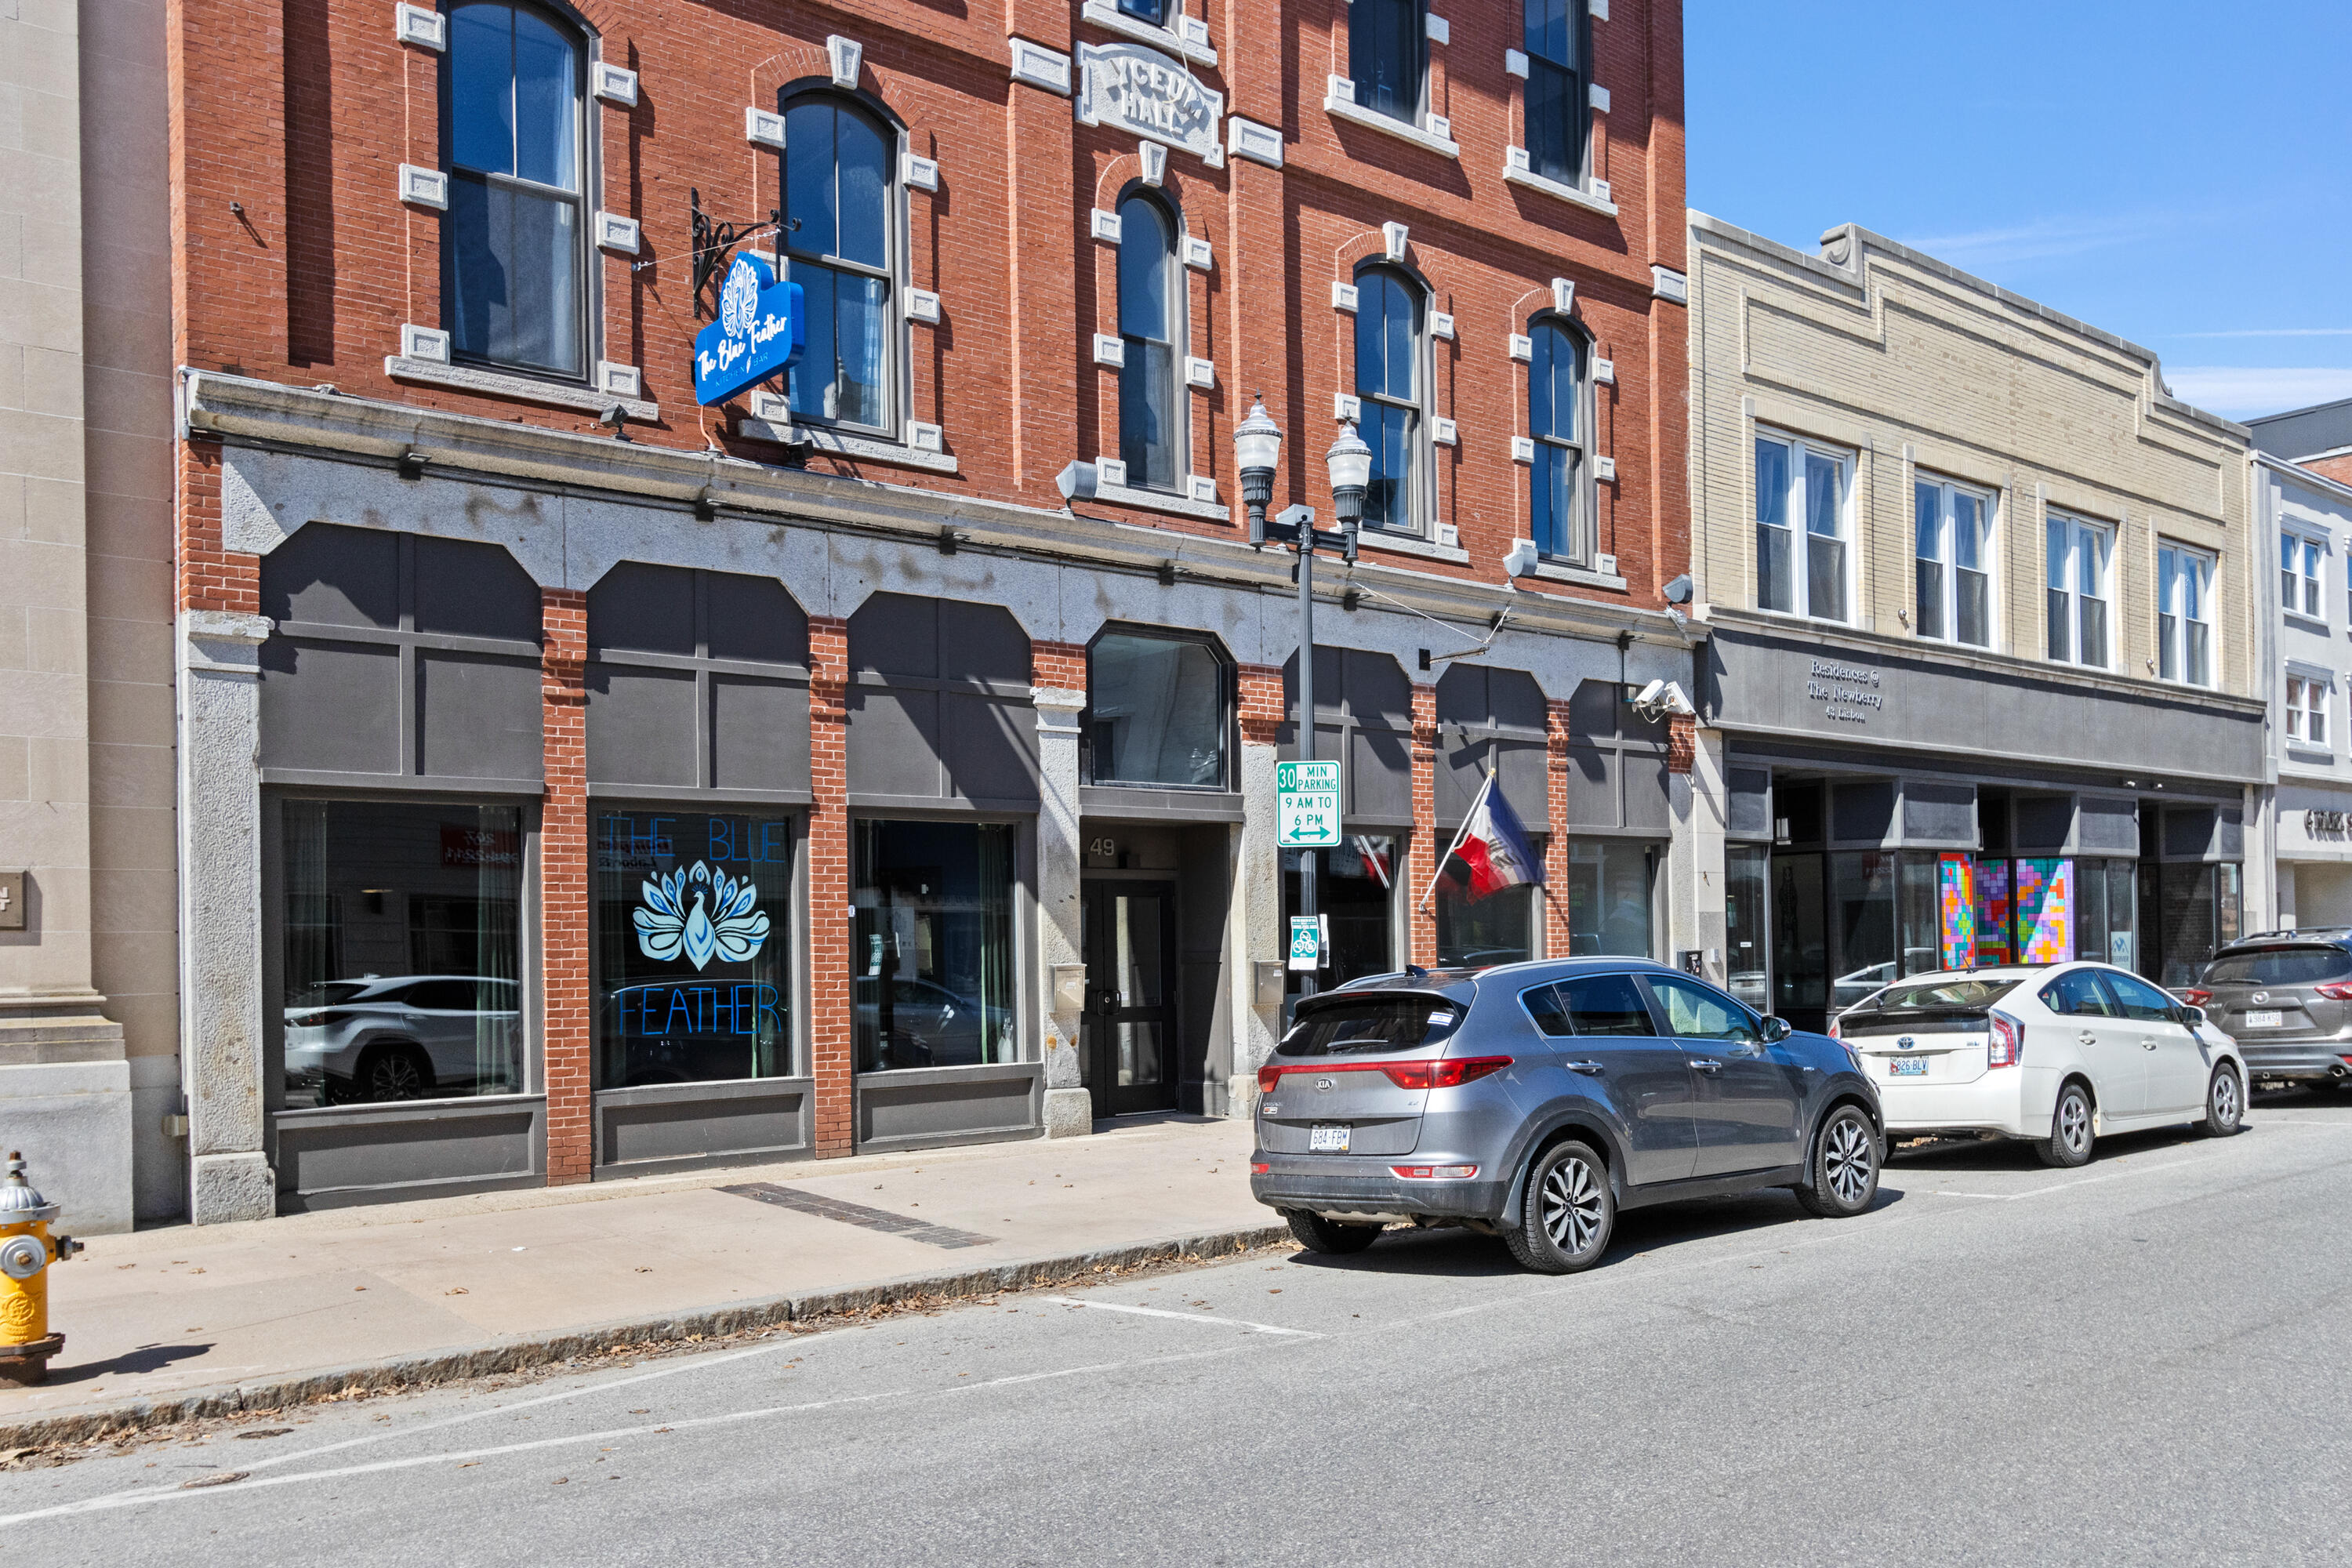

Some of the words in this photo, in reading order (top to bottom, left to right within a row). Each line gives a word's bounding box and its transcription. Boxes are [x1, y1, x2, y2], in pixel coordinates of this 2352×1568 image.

[1121, 89, 1184, 135] HALL
[698, 350, 717, 381] The
[717, 339, 746, 372] Blue
[747, 313, 787, 354] Feather
[715, 365, 745, 387] KITCHEN
[753, 351, 768, 367] BAR
[1810, 659, 1868, 682] Residences
[1871, 670, 1879, 684] @
[1807, 681, 1829, 697] The
[1832, 684, 1882, 709] Newberry
[1838, 707, 1865, 720] Lisbon
[1279, 768, 1296, 788] 30
[1307, 765, 1327, 778] MIN
[1298, 779, 1336, 789] PARKING
[1286, 797, 1292, 808] 9
[1297, 797, 1313, 808] AM
[1318, 797, 1331, 808] TO
[1294, 815, 1301, 826] 6
[1307, 814, 1323, 826] PM
[598, 816, 676, 857] THE
[710, 818, 784, 862] BLUE
[1090, 837, 1115, 856] 49
[619, 985, 782, 1036] FEATHER
[1317, 1080, 1331, 1089] KIA
